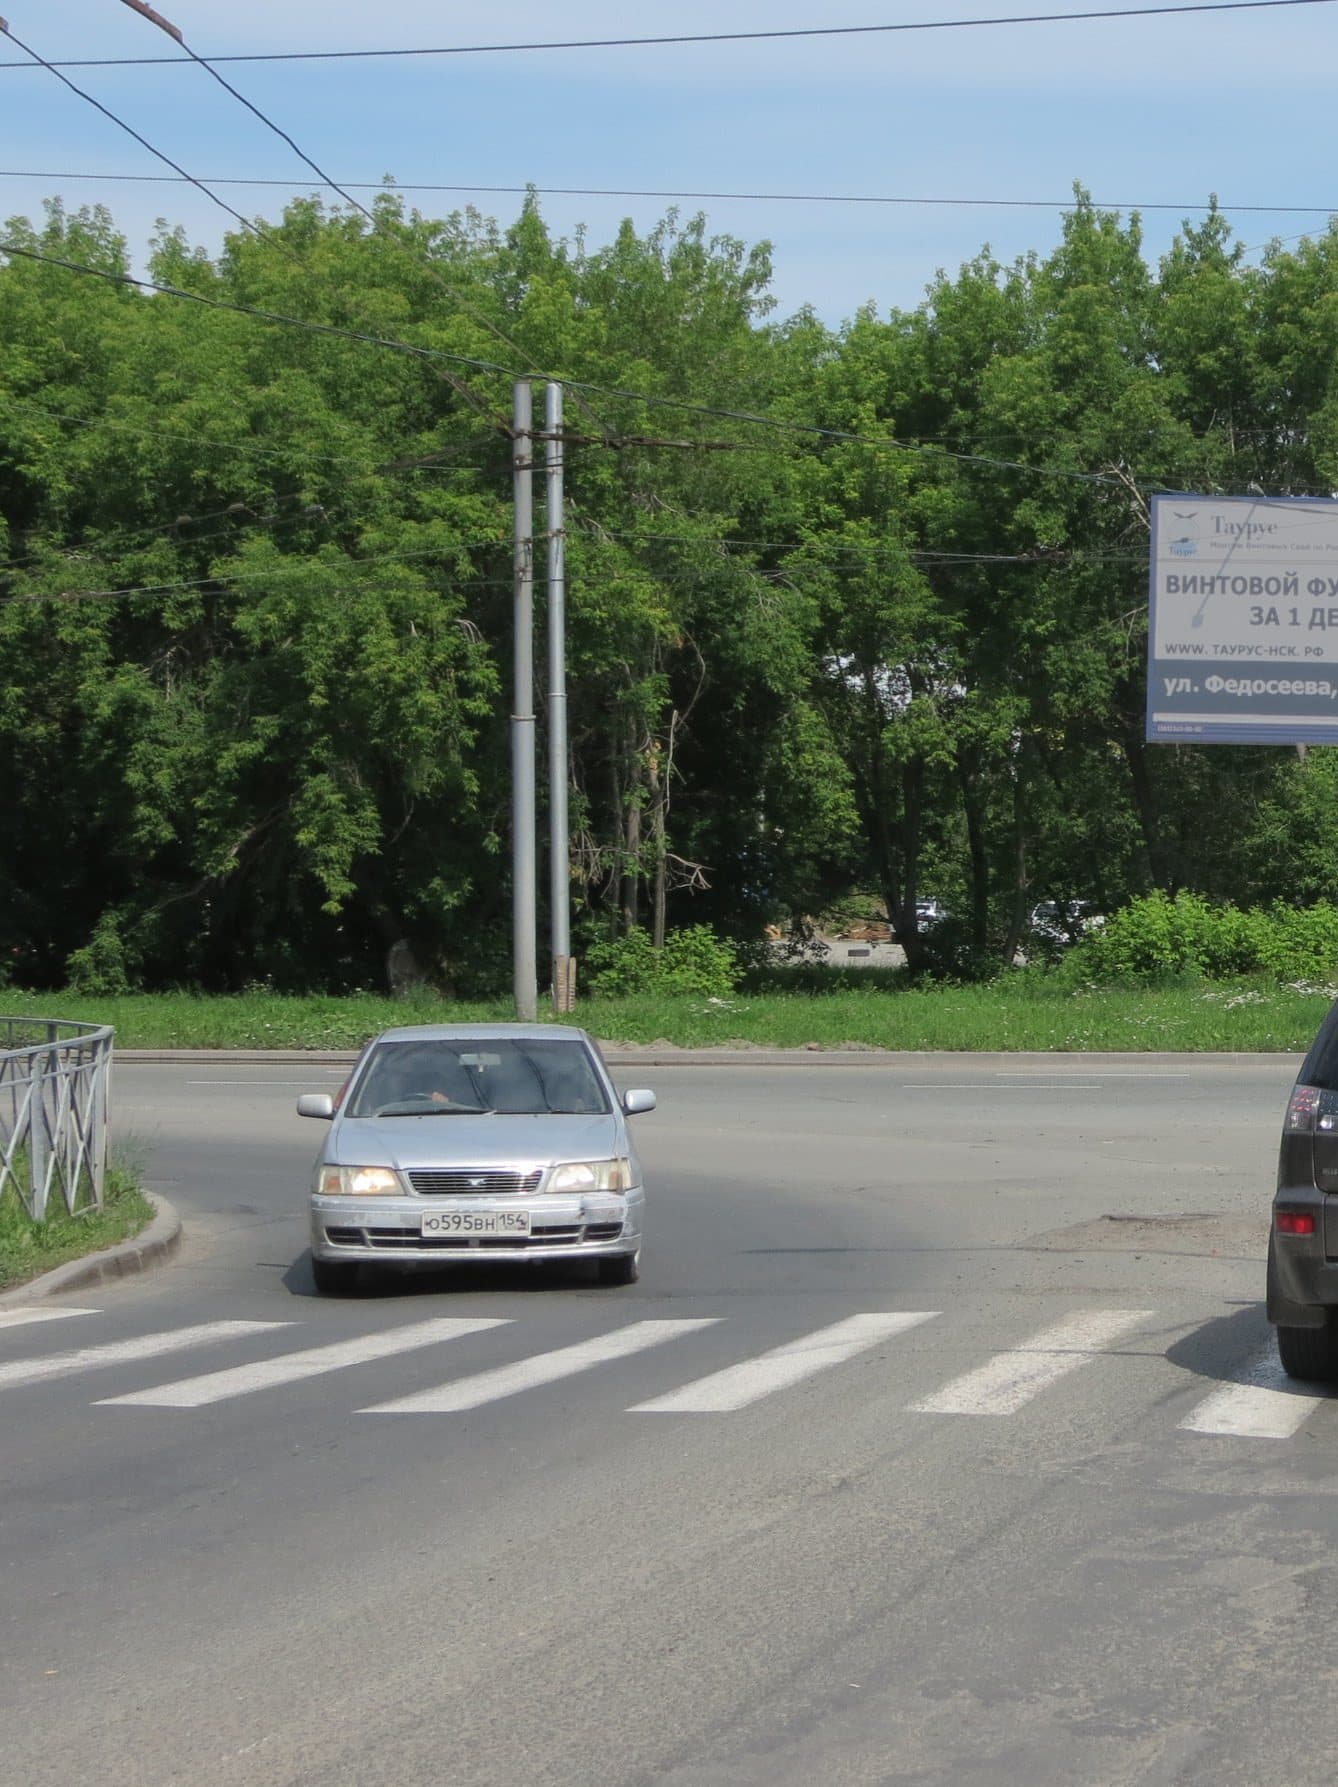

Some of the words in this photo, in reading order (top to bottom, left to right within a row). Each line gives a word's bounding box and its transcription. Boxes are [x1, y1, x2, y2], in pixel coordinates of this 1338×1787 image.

[1166, 571, 1300, 596] ВИНТОВОЙ
[1250, 606, 1280, 626] ЗА
[1288, 607, 1300, 626] 1
[1163, 677, 1199, 697] ул.
[1205, 675, 1338, 699] Федосеева,
